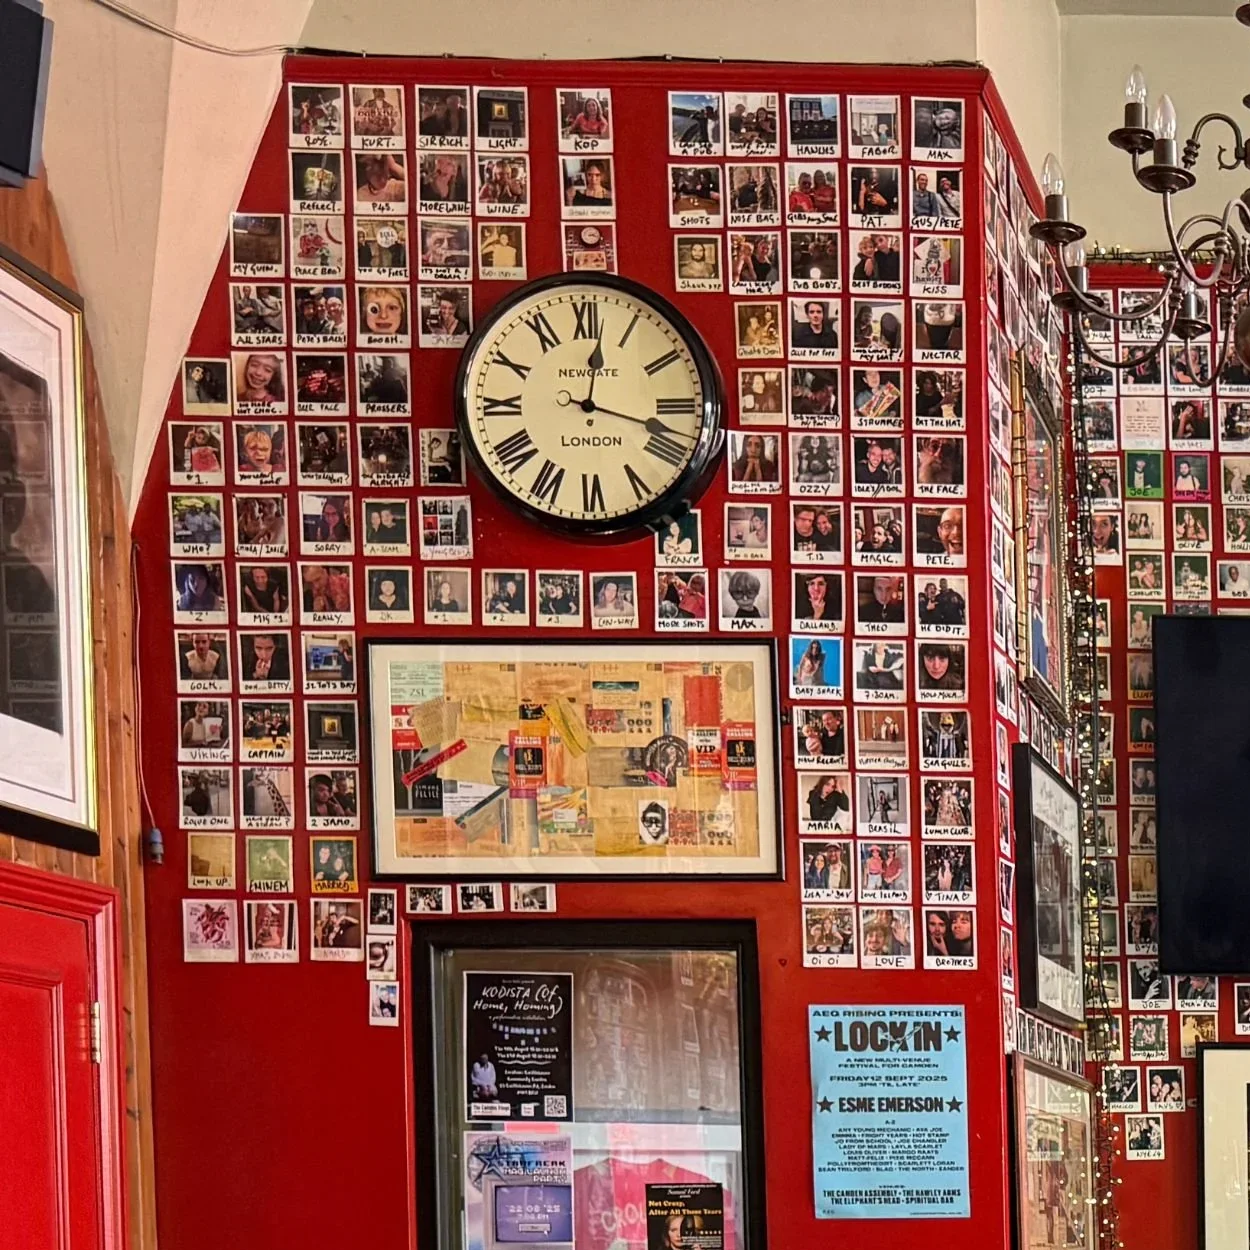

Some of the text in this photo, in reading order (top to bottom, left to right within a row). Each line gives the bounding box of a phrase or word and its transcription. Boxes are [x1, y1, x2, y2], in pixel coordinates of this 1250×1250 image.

[574, 139, 599, 150] KOP
[927, 150, 953, 159] MAX
[680, 217, 711, 225] SHOTS
[922, 286, 947, 294] KISS
[558, 367, 619, 378] NEWGATE
[560, 435, 622, 447] LONDON
[800, 484, 831, 494] OZZY
[926, 555, 954, 566] PETE.
[248, 750, 286, 759] CAPTAIN
[696, 745, 716, 754] VIP
[807, 823, 843, 831] MARIA
[875, 957, 906, 967] LOVE
[482, 985, 531, 999] KODISTA
[1142, 1000, 1161, 1009] JOE
[838, 1097, 944, 1113] ESME EMERSON
